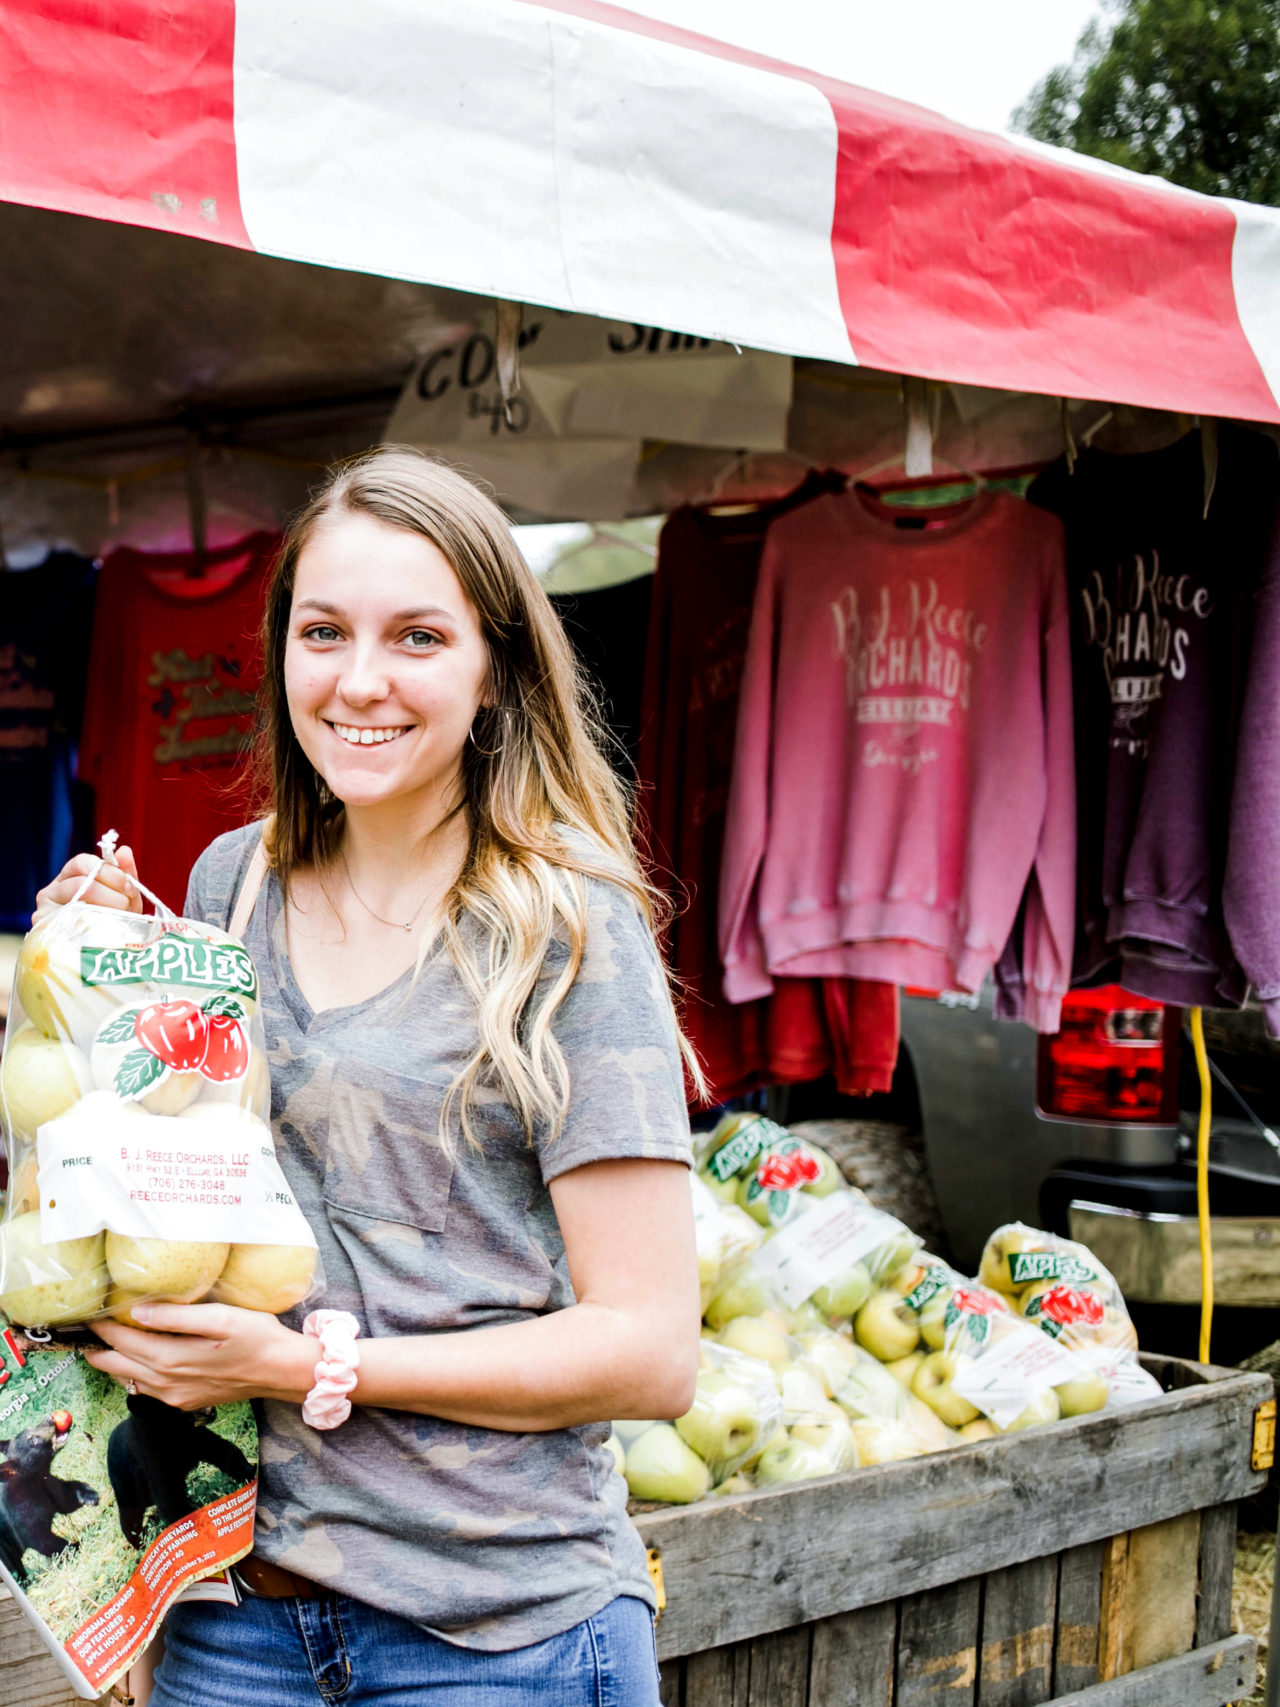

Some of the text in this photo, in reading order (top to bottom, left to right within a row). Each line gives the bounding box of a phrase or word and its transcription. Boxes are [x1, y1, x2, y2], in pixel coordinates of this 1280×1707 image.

[86, 938, 256, 992] APPLES
[62, 1156, 93, 1169] PRICE
[146, 1149, 174, 1163] REECE
[176, 1151, 228, 1166] ORCHARDS,
[231, 1153, 249, 1166] LLC
[213, 1167, 224, 1177] GA
[148, 1177, 226, 1191] (706) 276-3048
[130, 1189, 242, 1206] REECEORCHARDS.COM
[37, 1352, 78, 1388] October
[207, 1497, 238, 1518] COMPLETE
[212, 1517, 222, 1527] TO
[221, 1511, 233, 1523] THE
[217, 1523, 234, 1538] APPLE
[140, 1519, 195, 1576] CARTECAY VINEYARDS
[144, 1529, 199, 1584] CONTINUES FARMING
[148, 1549, 185, 1592] TRADITION 40
[174, 1558, 197, 1577] October
[71, 1585, 135, 1650] PANORAMA ORCHARDS
[78, 1614, 124, 1658] OUR FEATURED
[85, 1614, 136, 1668] APPLE HOUSE 10
